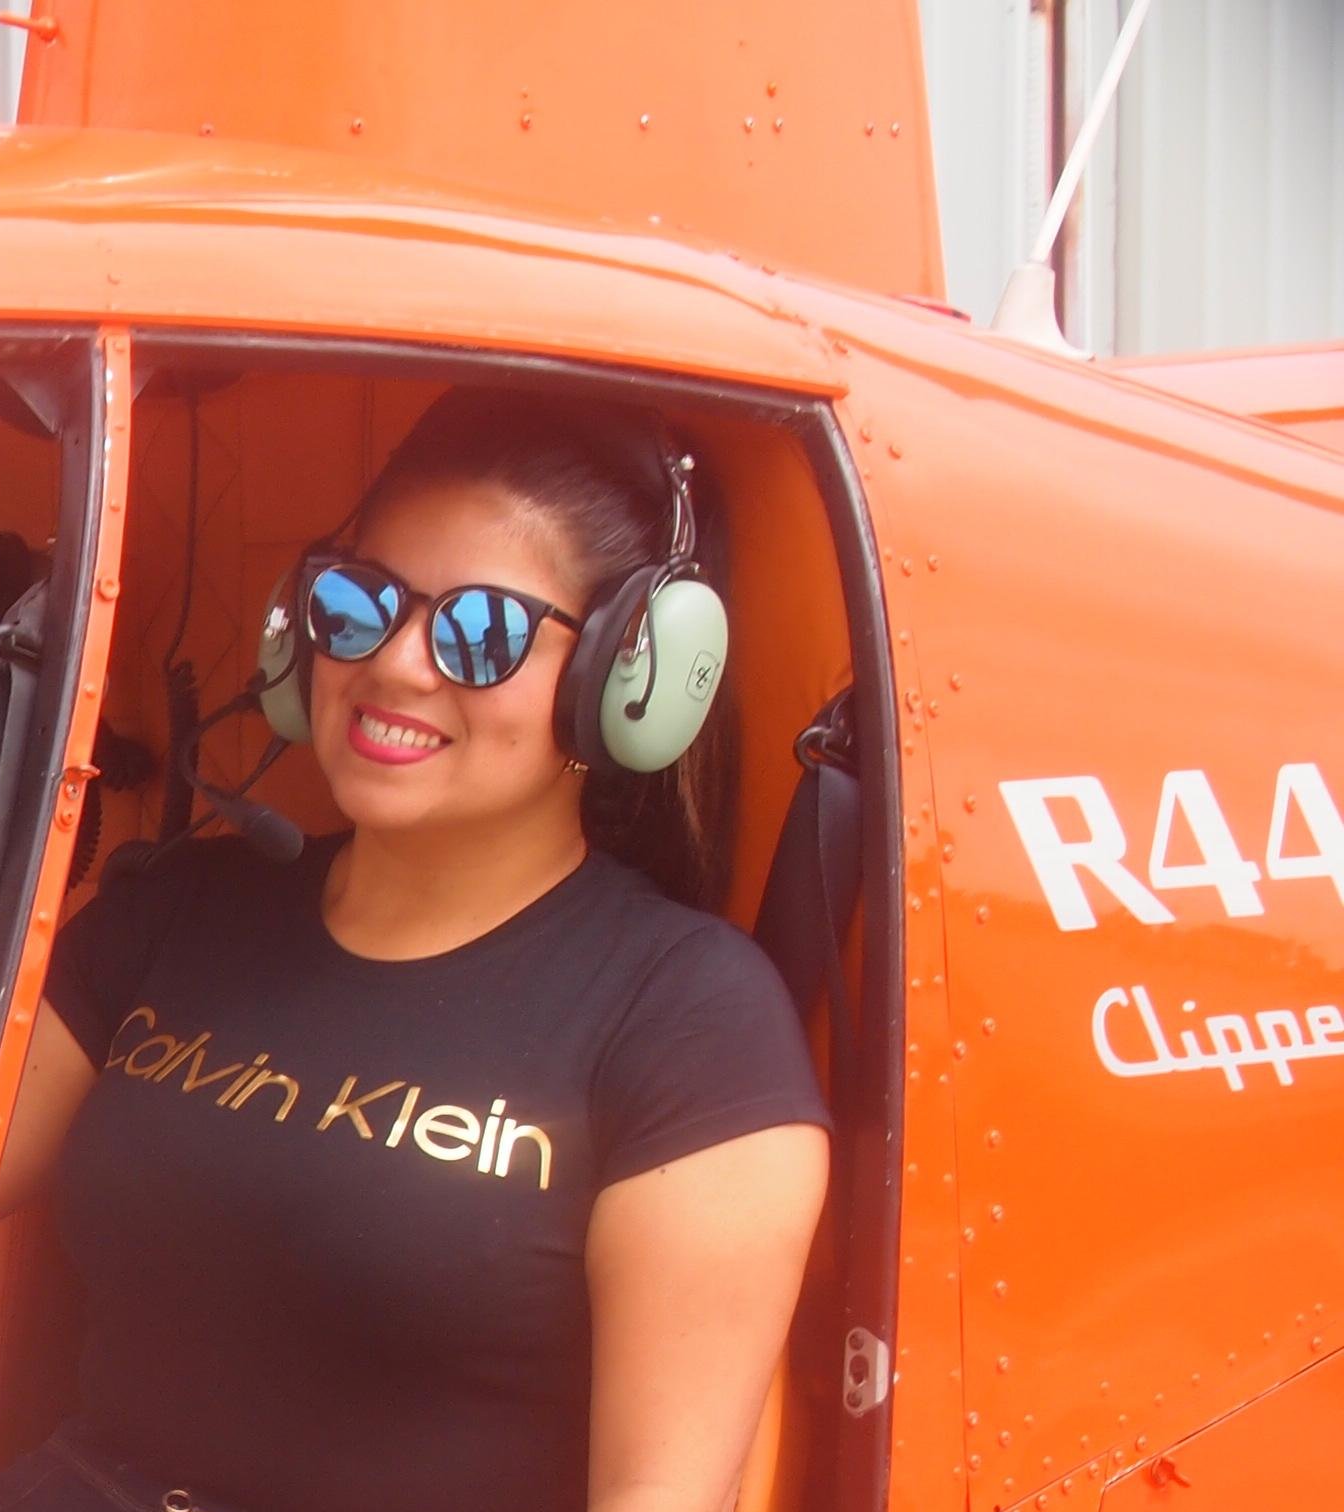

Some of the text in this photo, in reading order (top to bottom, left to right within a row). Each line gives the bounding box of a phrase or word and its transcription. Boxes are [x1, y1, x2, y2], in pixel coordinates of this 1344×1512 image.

[998, 762, 1344, 932] R44
[105, 1006, 552, 1190] Calvin Klein
